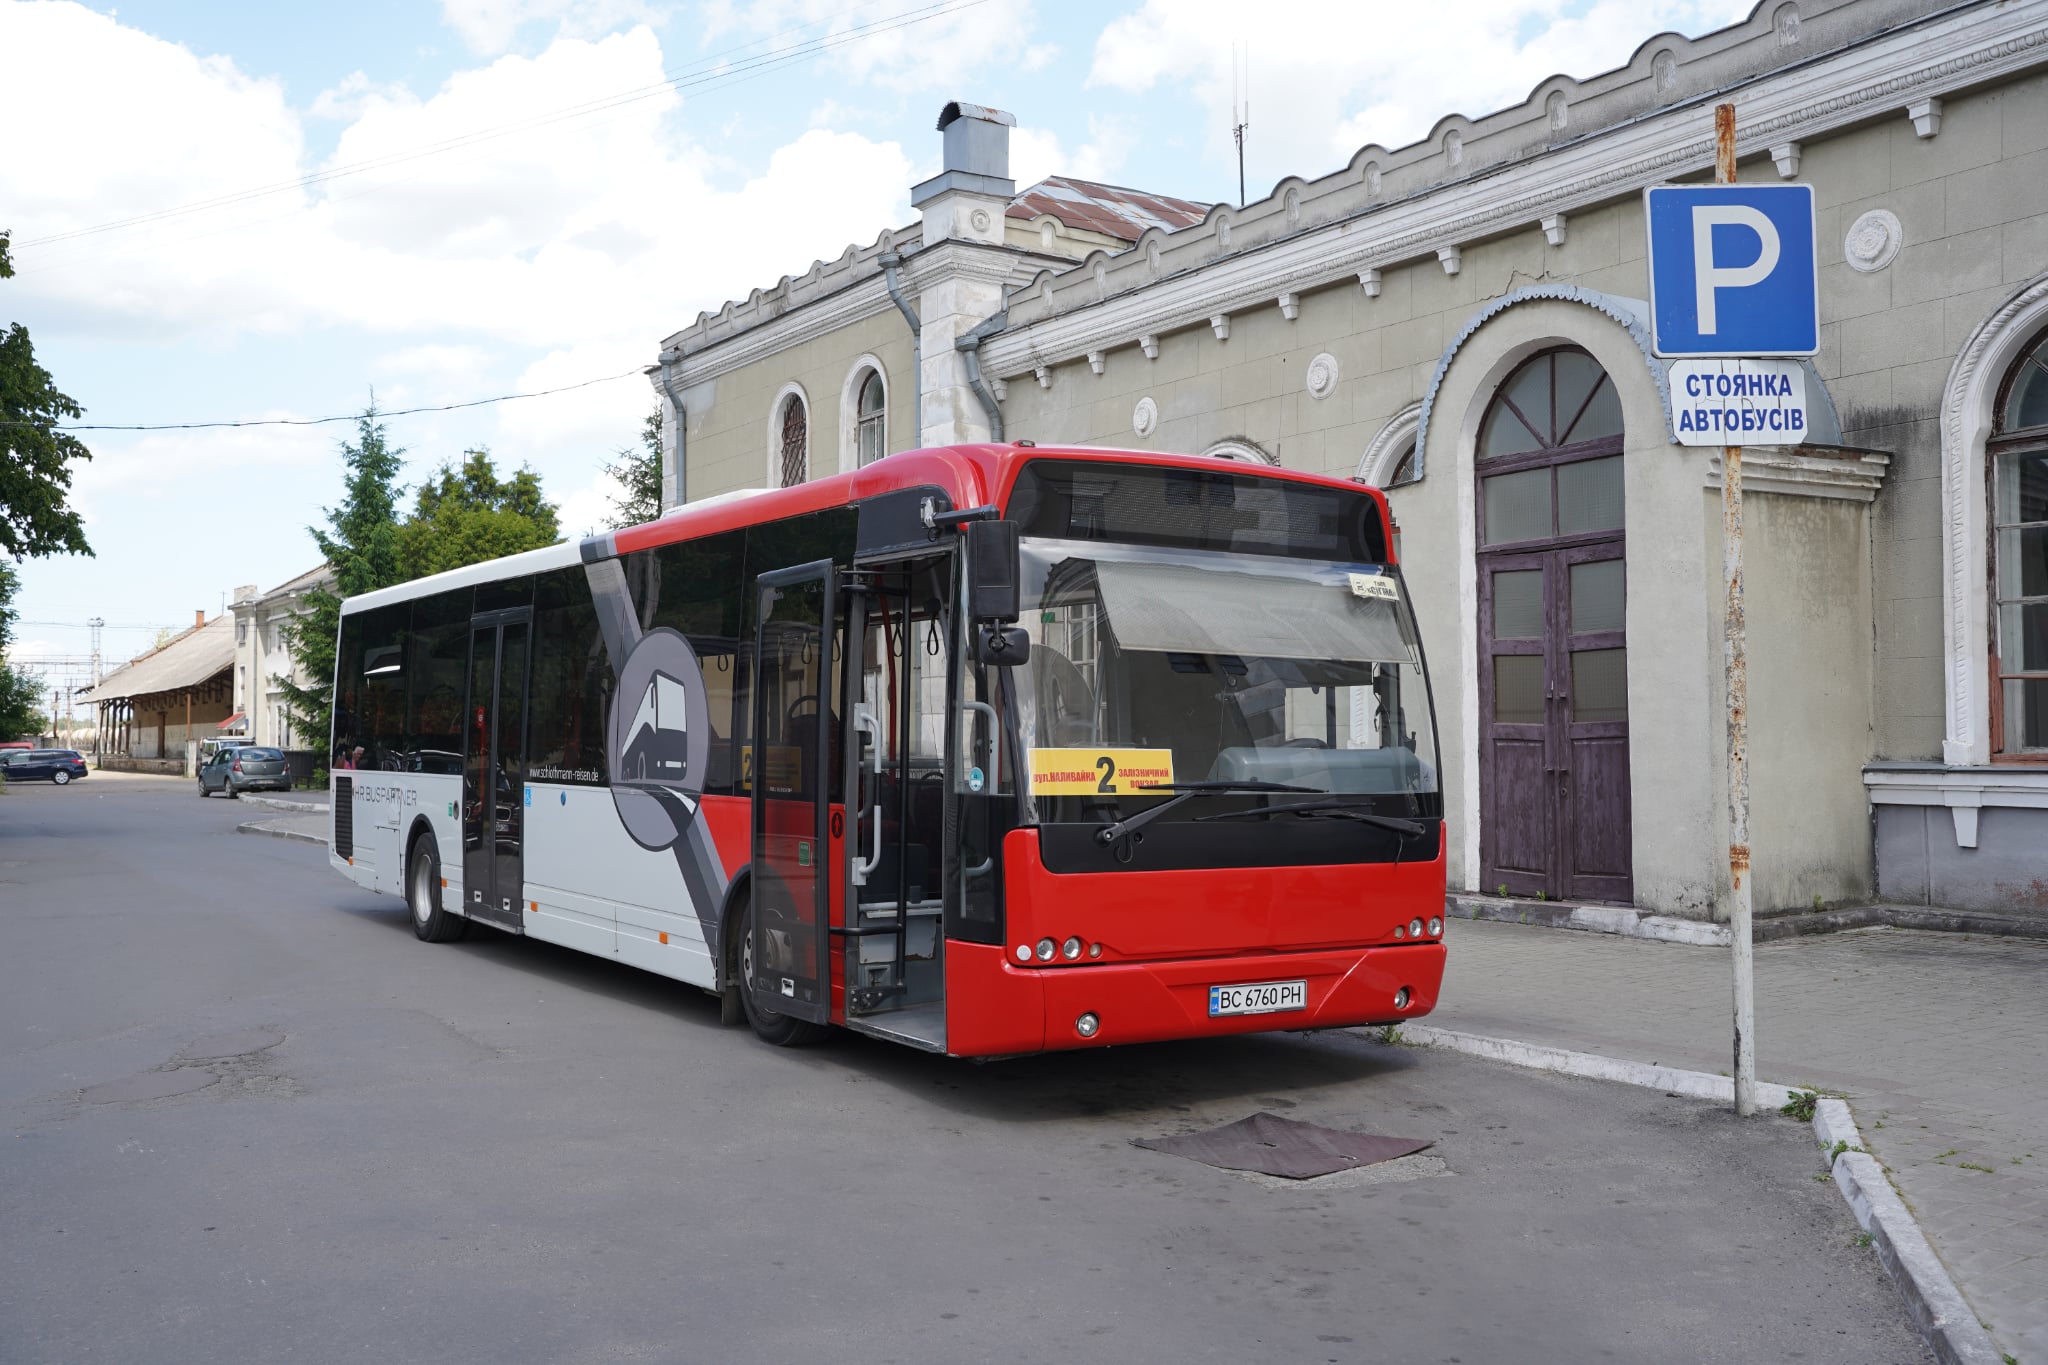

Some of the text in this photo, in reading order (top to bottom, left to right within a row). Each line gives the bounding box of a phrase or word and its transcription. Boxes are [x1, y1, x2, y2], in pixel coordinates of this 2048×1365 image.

[1692, 205, 1781, 335] P
[1686, 373, 1793, 397] СТОЯНКА
[1679, 408, 1804, 432] АВТОБУСІВ
[1095, 756, 1117, 794] 2
[1118, 768, 1169, 778] ЗАЛІЗНИЧНИЙ
[1220, 985, 1301, 1009] BC 6760 PH
